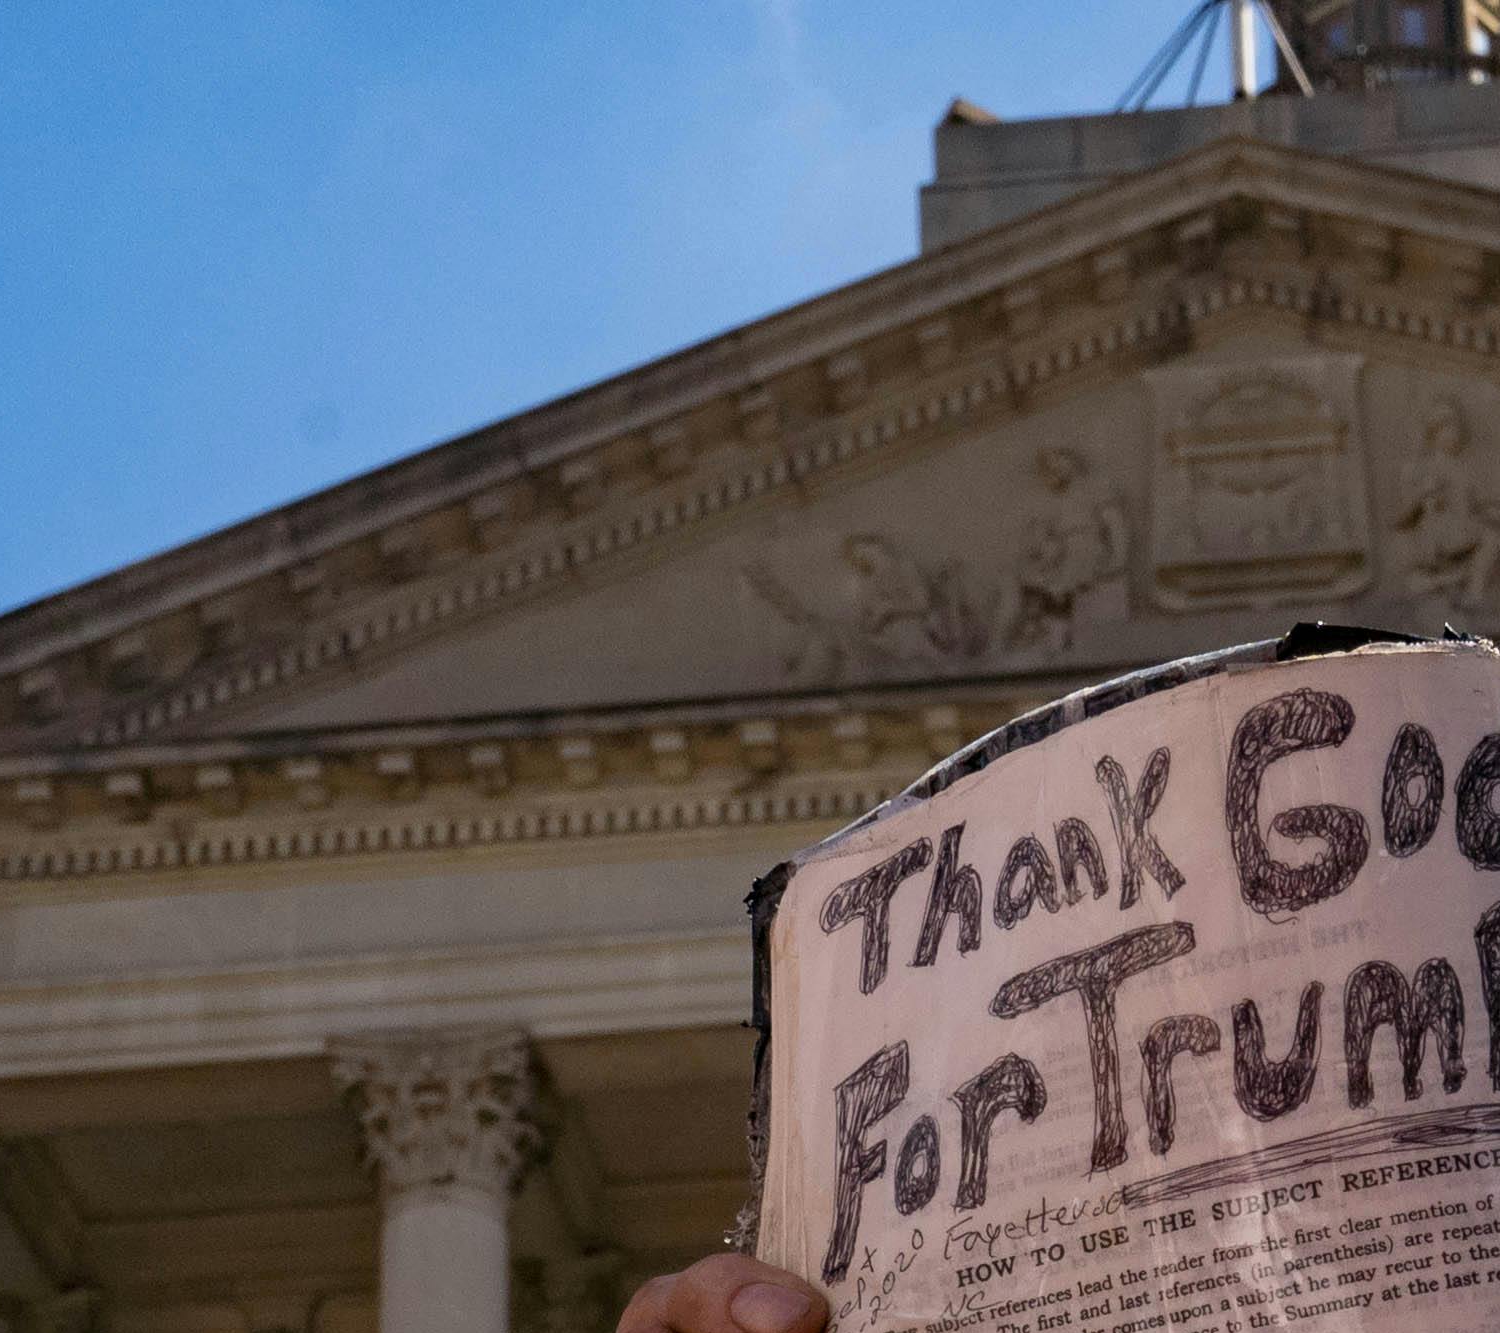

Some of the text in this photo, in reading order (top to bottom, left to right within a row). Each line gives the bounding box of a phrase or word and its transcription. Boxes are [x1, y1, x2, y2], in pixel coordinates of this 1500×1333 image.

[822, 1040, 1048, 1287] For
[956, 1255, 1016, 1288] HOW
[1024, 1243, 1065, 1267] TO
[1080, 1226, 1129, 1254] USE
[1143, 1209, 1196, 1237] THE
[1211, 1179, 1323, 1222] SUBJECT
[989, 1289, 1073, 1320] references
[1077, 1274, 1113, 1297] lead
[1119, 1269, 1148, 1286] the
[1153, 1255, 1205, 1279] reader
[1212, 1245, 1254, 1264] from
[1261, 1235, 1288, 1253] the
[1294, 1226, 1332, 1245] first
[1338, 1217, 1383, 1236] clear
[1389, 1201, 1468, 1226] mention
[1475, 1193, 1494, 1212] of
[1037, 1311, 1072, 1332] first
[1080, 1299, 1112, 1321] and
[1118, 1291, 1151, 1311] last
[1158, 1272, 1241, 1302] references
[1251, 1266, 1275, 1282] (in
[1283, 1235, 1394, 1276] parenthesis)
[1404, 1232, 1434, 1248] are
[1248, 1311, 1276, 1329] the
[1284, 1292, 1374, 1321] Summary
[1381, 1284, 1402, 1302] at
[1407, 1278, 1439, 1296] the
[1444, 1271, 1481, 1290] last
